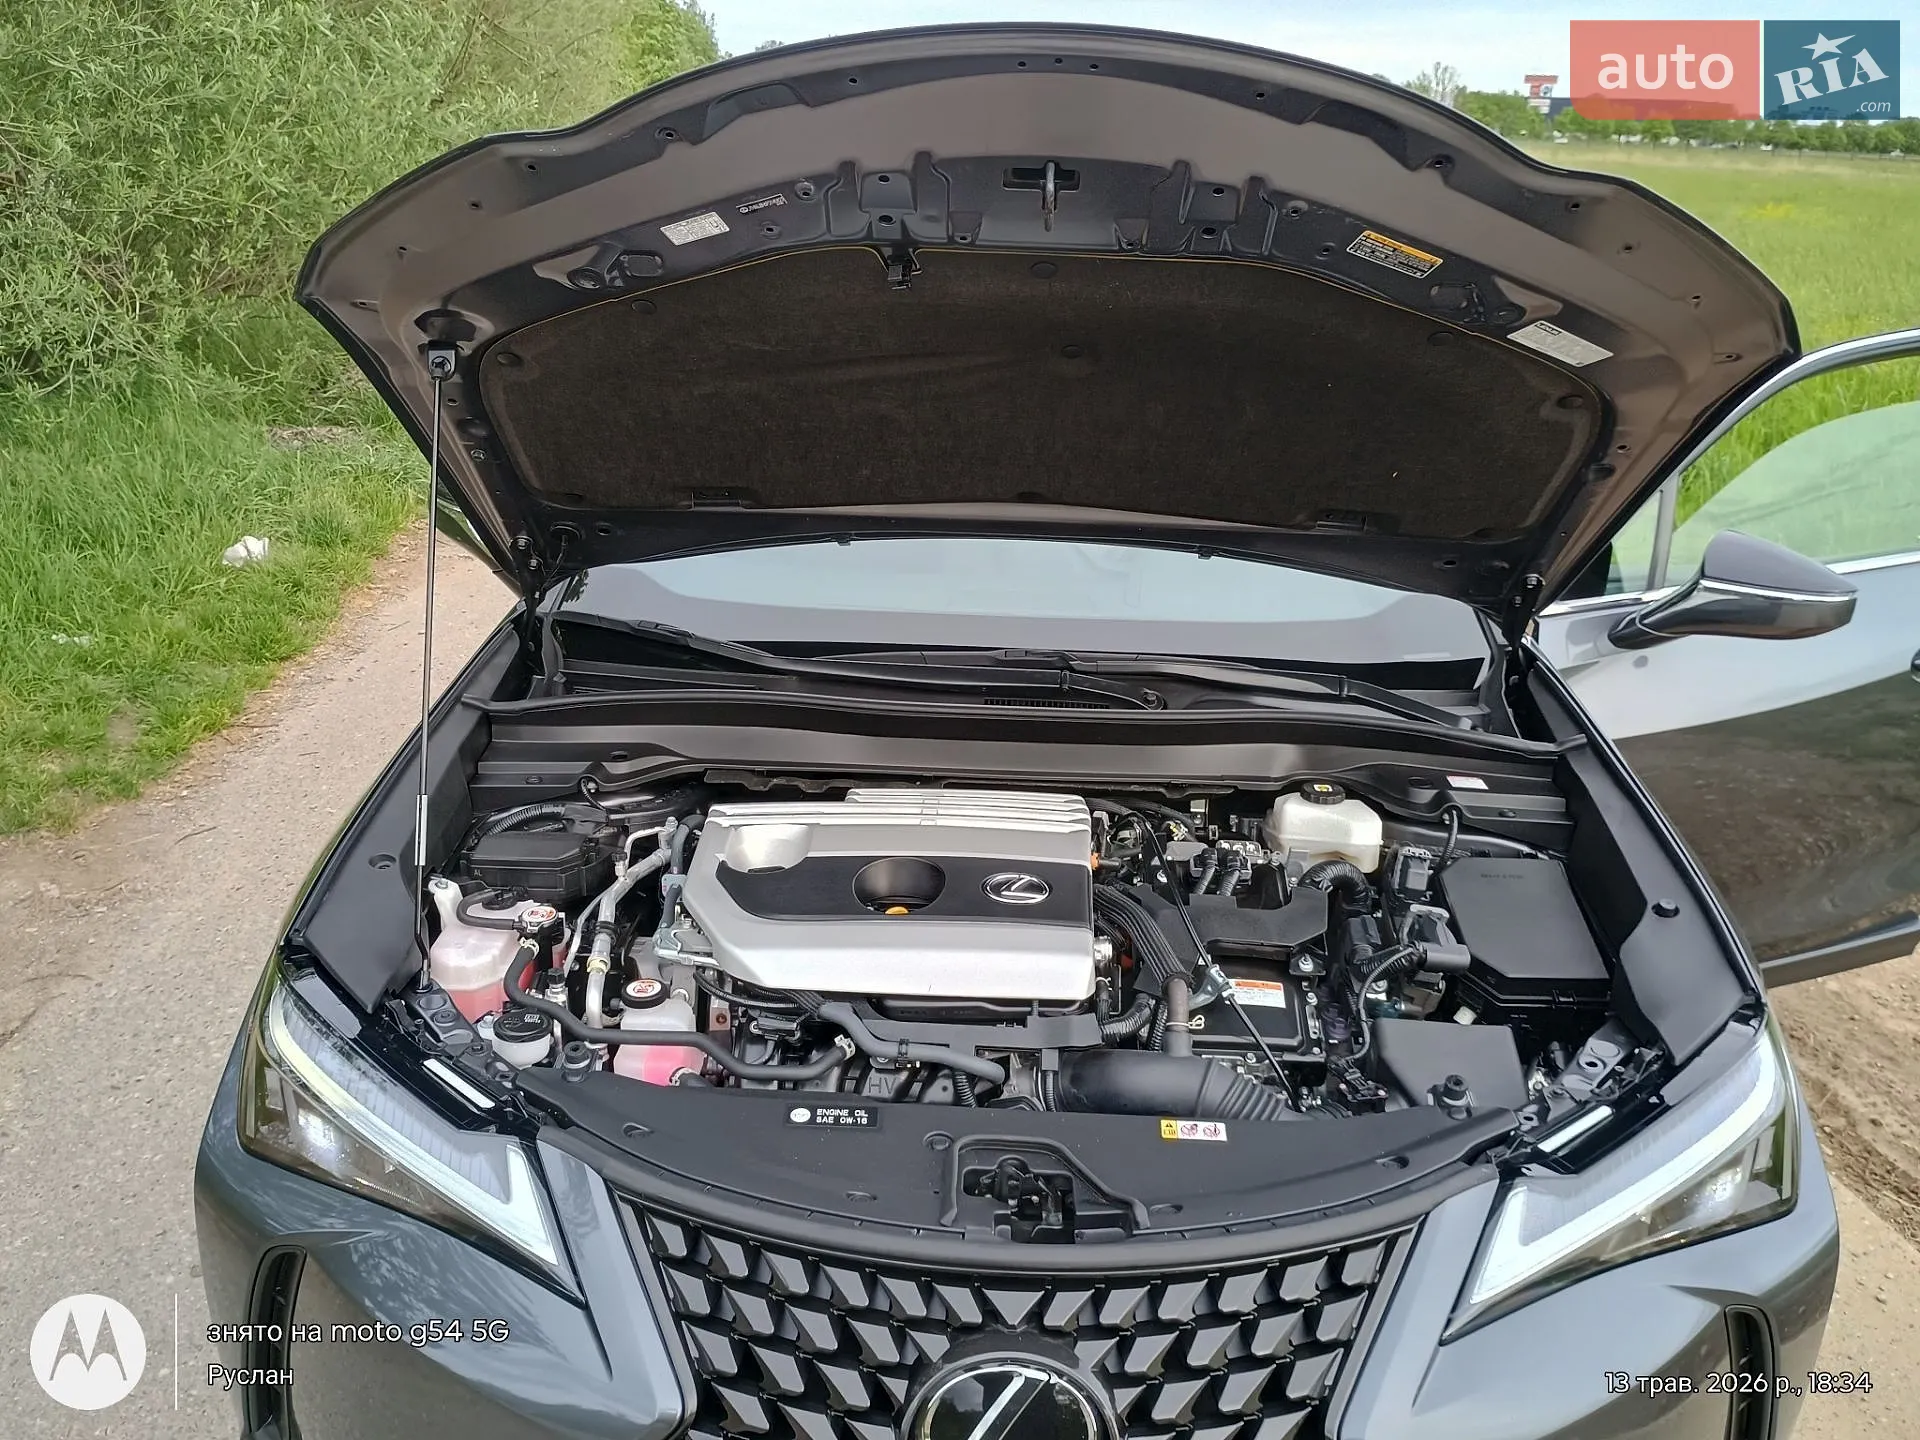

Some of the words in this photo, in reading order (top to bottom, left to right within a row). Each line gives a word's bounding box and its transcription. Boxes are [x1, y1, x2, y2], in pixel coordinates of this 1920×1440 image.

[868, 1076, 897, 1095] HV
[816, 1108, 849, 1116] ENGINE
[816, 1116, 835, 1124] SAE
